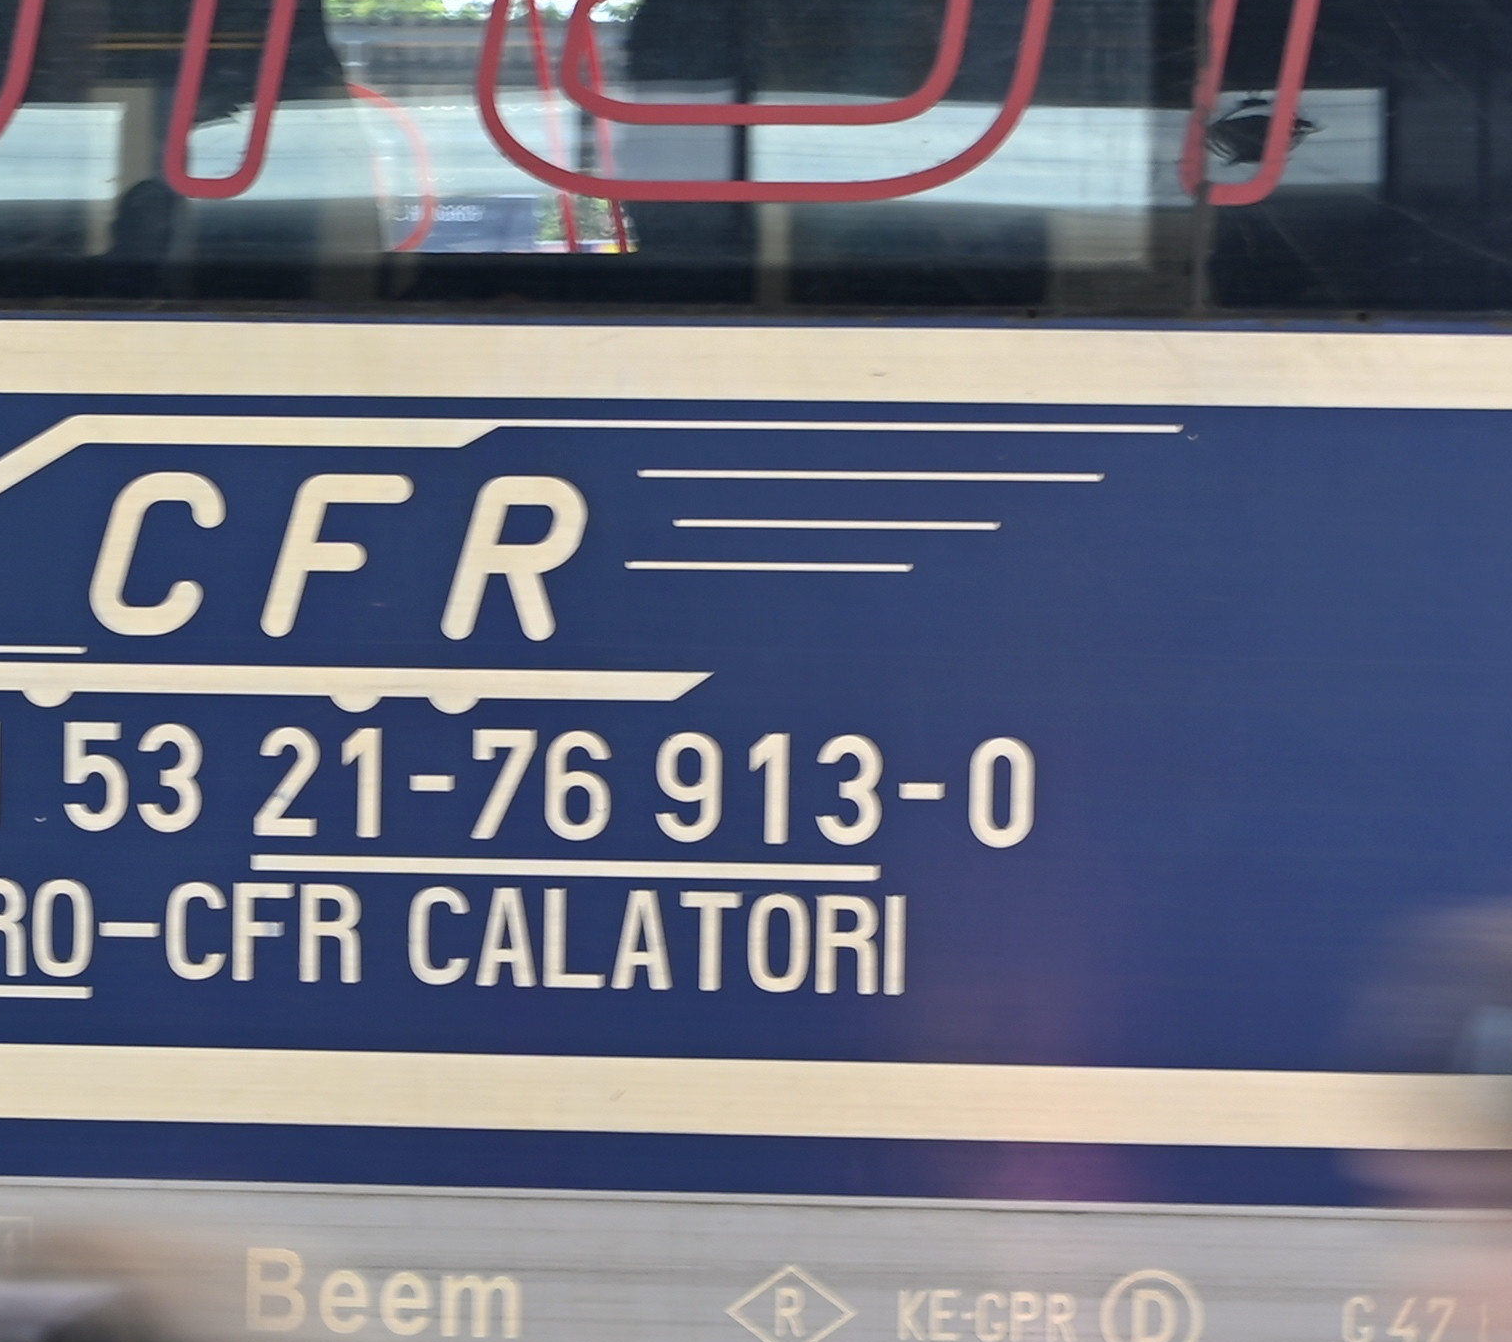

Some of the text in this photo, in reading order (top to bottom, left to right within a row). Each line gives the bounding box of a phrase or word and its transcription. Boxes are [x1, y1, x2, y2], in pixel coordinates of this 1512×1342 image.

[87, 469, 589, 643] CFR
[61, 720, 204, 834] 53
[251, 724, 613, 842] 21-76
[653, 731, 1036, 850] 913-0
[406, 884, 908, 998] CALATORI
[245, 1246, 524, 1339] Beem
[774, 1287, 808, 1338] R
